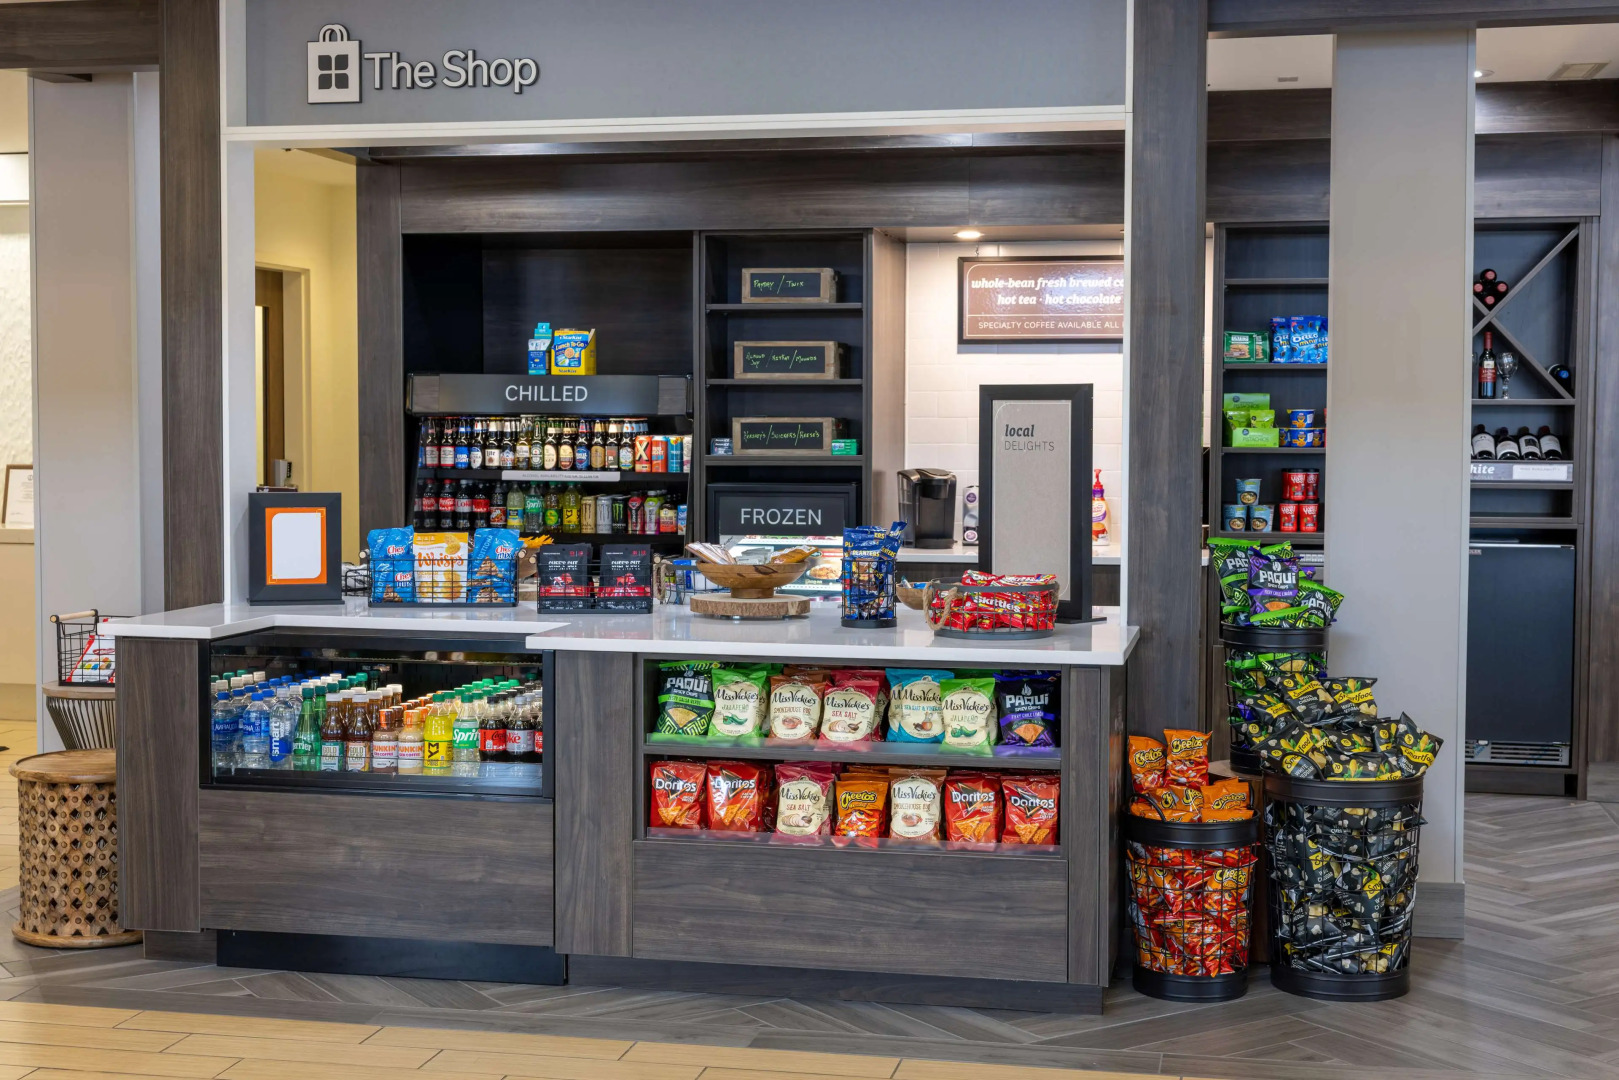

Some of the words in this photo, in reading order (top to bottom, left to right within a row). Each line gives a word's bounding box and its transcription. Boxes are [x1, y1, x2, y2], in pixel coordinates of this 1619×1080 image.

[364, 51, 436, 90] The
[442, 49, 539, 94] Shop
[786, 280, 804, 288] TWIX
[971, 277, 1035, 289] whole-bean
[1035, 277, 1066, 291] fresh
[1069, 276, 1112, 289] brewed
[997, 293, 1016, 305] hot
[1019, 295, 1037, 305] tea
[1044, 293, 1064, 305] hot
[1066, 293, 1122, 305] chocolate
[978, 321, 1022, 330] SPECIALTY
[1024, 321, 1055, 329] COFFEE
[1057, 321, 1102, 329] AVAILABLE
[1104, 320, 1119, 329] ALL
[1293, 333, 1319, 343] OREO
[505, 385, 588, 402] CHILLED
[1004, 424, 1035, 437] local
[1004, 441, 1055, 451] DELIGHTS
[1470, 464, 1495, 474] hite
[525, 500, 544, 509] Sprit
[740, 508, 822, 525] FROZEN
[387, 544, 405, 554] Chex
[495, 545, 512, 554] Chex
[417, 552, 464, 568] Whisps
[395, 572, 412, 582] Chex
[973, 595, 1020, 613] Skittles
[844, 711, 858, 719] SALT
[452, 728, 480, 743] Sprit
[506, 731, 521, 743] ke
[655, 777, 697, 792] Doritos
[714, 778, 755, 791] Doritos
[840, 790, 877, 808] Cheetos
[952, 790, 995, 803] Doritos
[1011, 795, 1055, 808] Doritos
